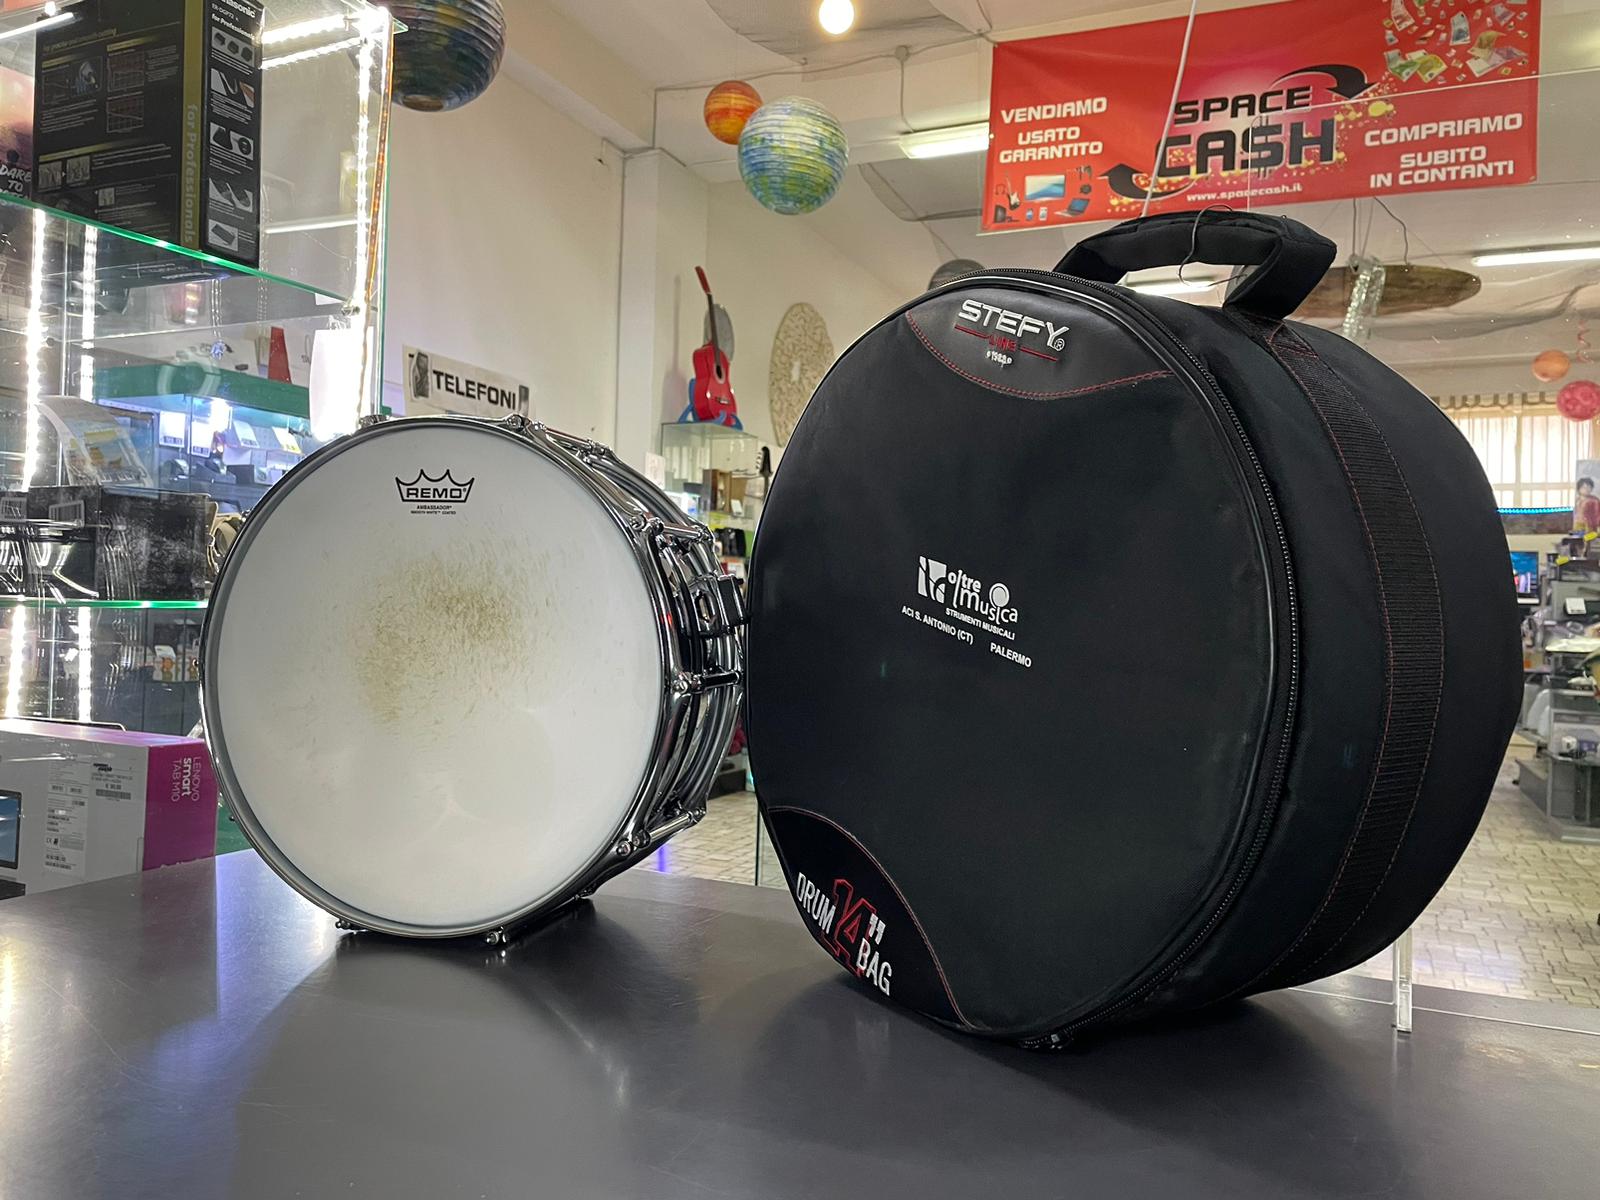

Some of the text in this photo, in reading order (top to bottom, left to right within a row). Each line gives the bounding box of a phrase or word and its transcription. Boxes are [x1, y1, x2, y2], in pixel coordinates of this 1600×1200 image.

[1001, 97, 1107, 124] VENDIAMO
[1174, 86, 1311, 126] SPACE
[1018, 126, 1081, 145] USATO
[1364, 113, 1523, 147] COMPRIAMO
[999, 141, 1103, 163] GARANTITO
[1400, 145, 1487, 168] SUBITO
[0, 164, 32, 182] DARE
[8, 179, 24, 193] TO
[184, 103, 198, 243] for Professionals
[1369, 160, 1514, 188] IN CONTANTI
[1187, 183, 1303, 202] www.spacecash.it
[432, 369, 516, 411] TELEFONI
[947, 569, 981, 608] oltre
[959, 583, 1019, 625] musica
[901, 605, 1032, 668] ACI S. ANTONIO (CT) PALERMO
[945, 607, 1016, 640] STRUMENTI MUSICALI
[172, 758, 183, 781] TAB
[181, 757, 192, 797] smart
[191, 756, 202, 802] LENOVO
[797, 872, 836, 934] DRUM
[856, 937, 892, 996] BAG
